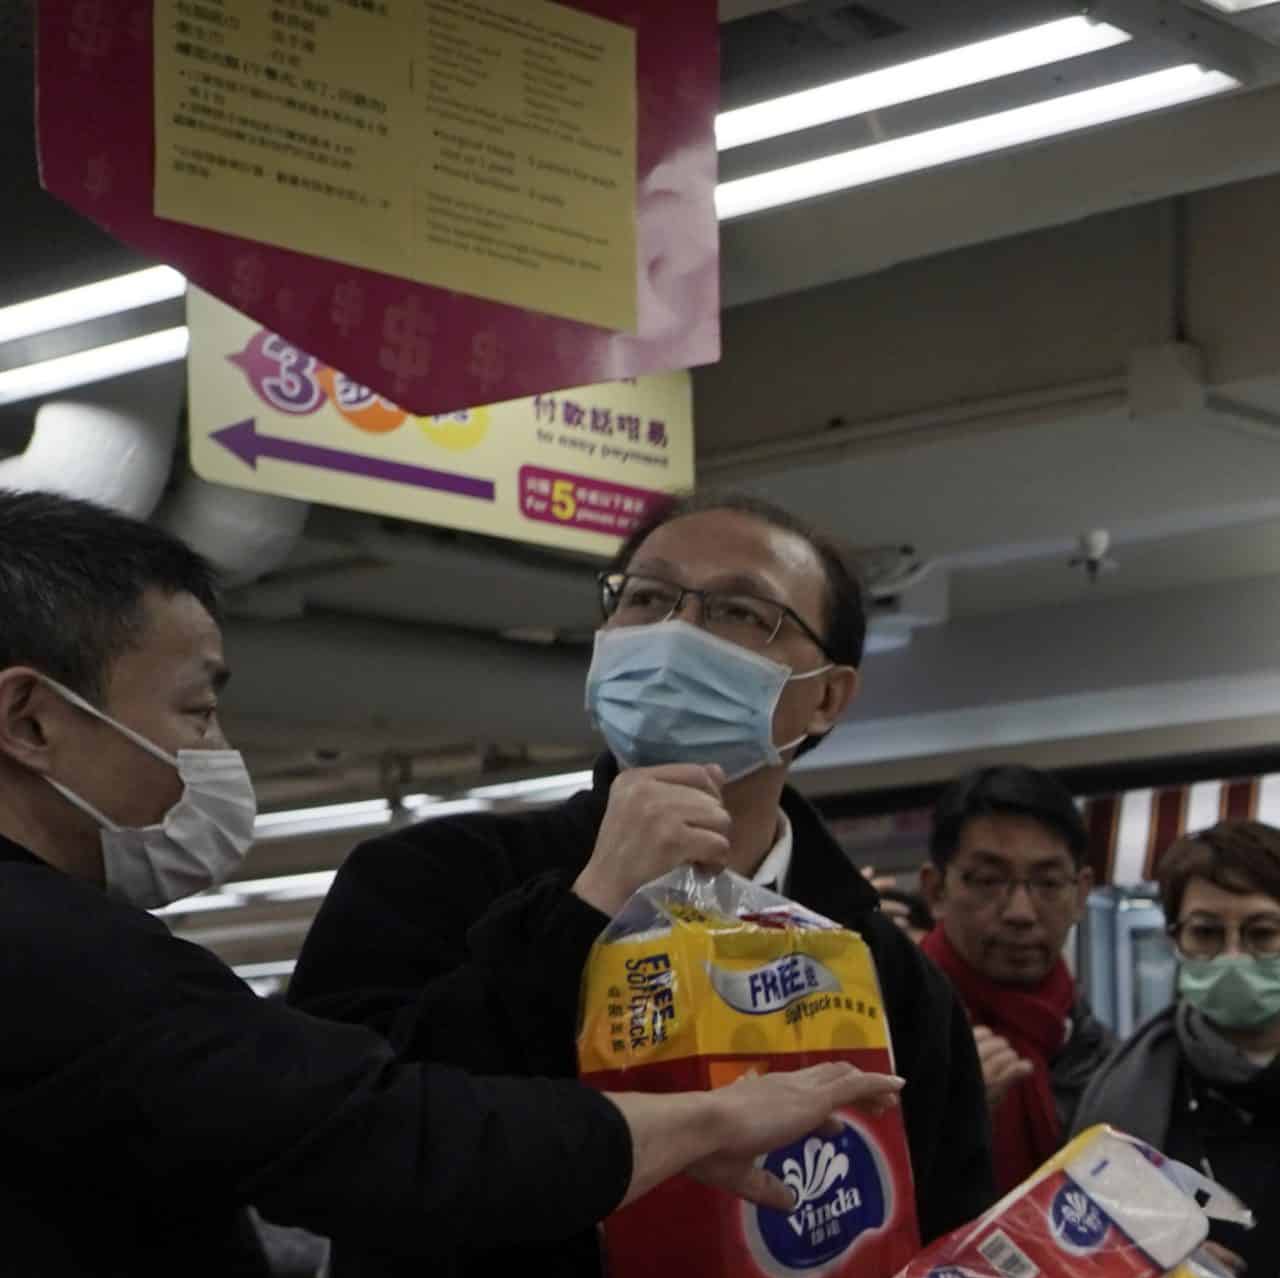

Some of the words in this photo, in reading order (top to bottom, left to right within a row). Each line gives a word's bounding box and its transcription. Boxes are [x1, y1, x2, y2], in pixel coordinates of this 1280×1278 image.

[558, 434, 596, 457] easy
[601, 445, 670, 469] payment
[551, 479, 576, 521] 5
[748, 957, 807, 1008] FREE
[787, 1186, 862, 1237] Vinda
